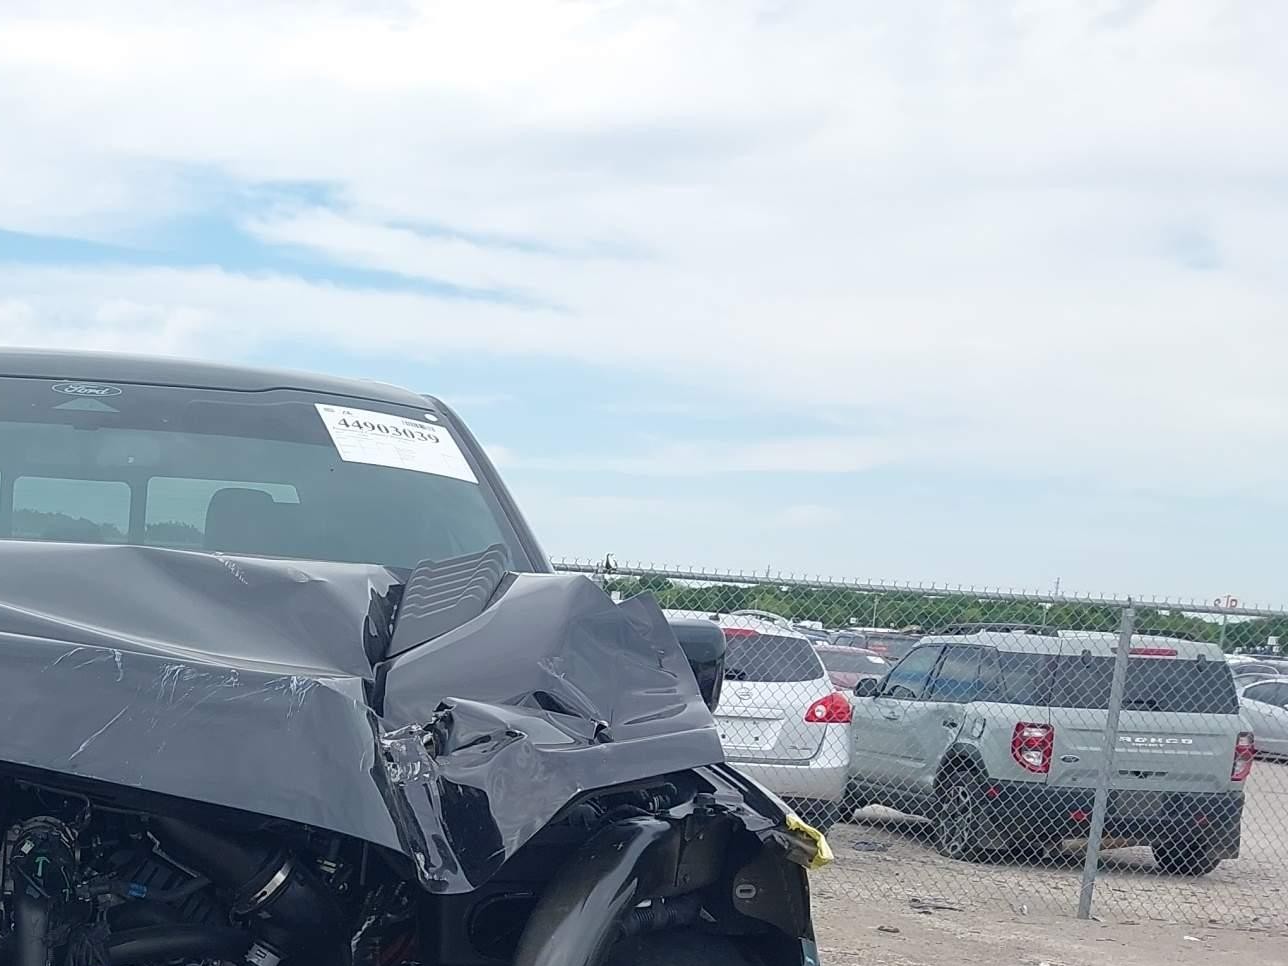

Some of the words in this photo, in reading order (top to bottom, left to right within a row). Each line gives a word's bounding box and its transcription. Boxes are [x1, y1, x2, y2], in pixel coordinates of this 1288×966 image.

[64, 383, 110, 395] Ford
[337, 417, 441, 444] 44903039
[1102, 735, 1193, 745] RONCO
